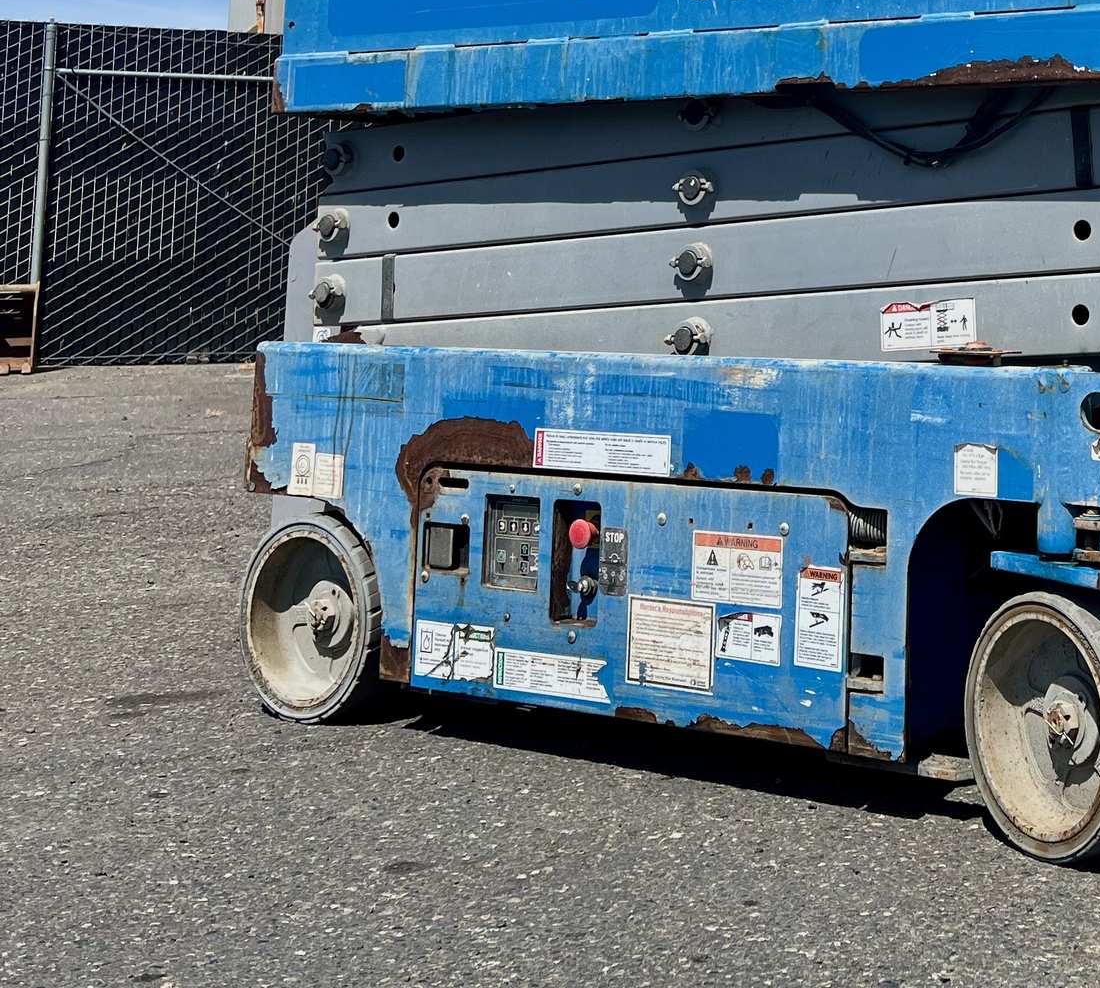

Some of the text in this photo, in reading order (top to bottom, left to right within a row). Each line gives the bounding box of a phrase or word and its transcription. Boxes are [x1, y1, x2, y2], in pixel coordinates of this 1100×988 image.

[605, 531, 625, 543] STOP
[723, 538, 759, 549] WARNING
[809, 570, 838, 581] WARNING
